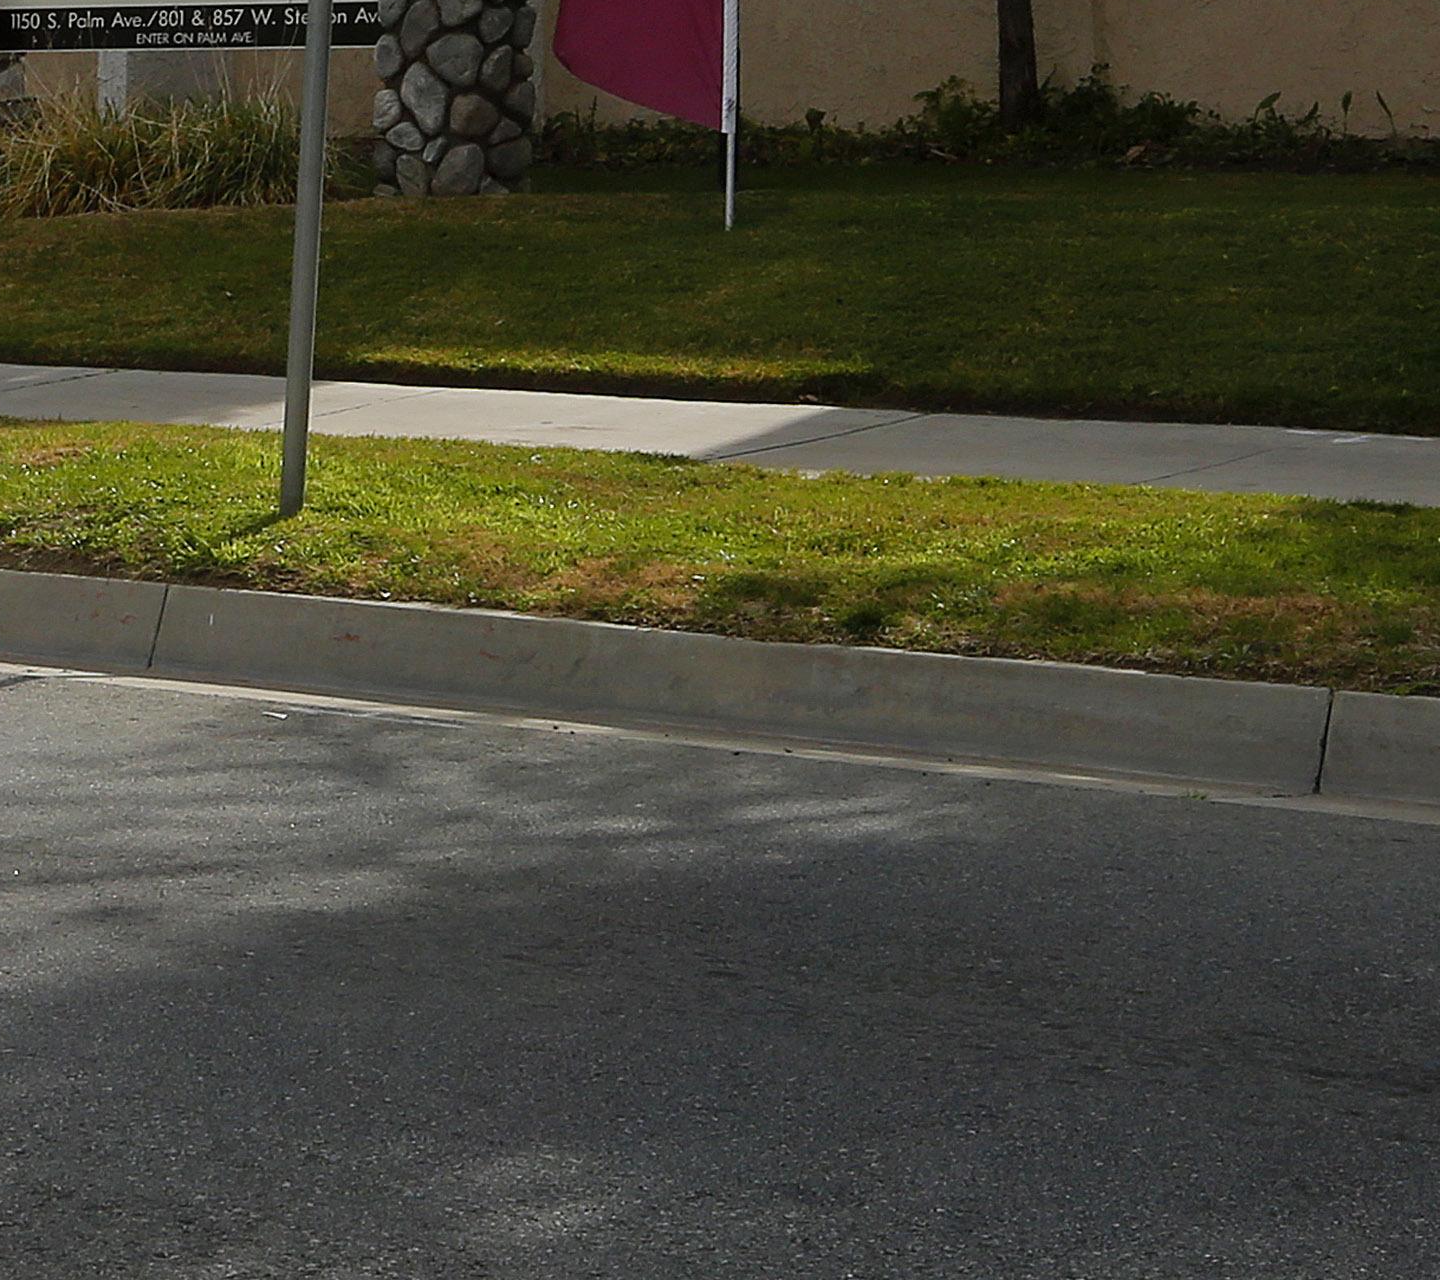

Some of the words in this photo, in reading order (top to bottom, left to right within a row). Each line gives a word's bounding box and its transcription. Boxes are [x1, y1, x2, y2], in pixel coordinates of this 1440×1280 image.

[10, 12, 41, 30] 1150
[68, 10, 105, 29] Palm
[191, 9, 205, 27] &
[212, 8, 244, 26] 857
[251, 8, 276, 26] W.
[284, 7, 347, 25] Steon
[135, 33, 170, 45] ENTER
[173, 32, 195, 45] ON
[197, 32, 227, 44] PALM
